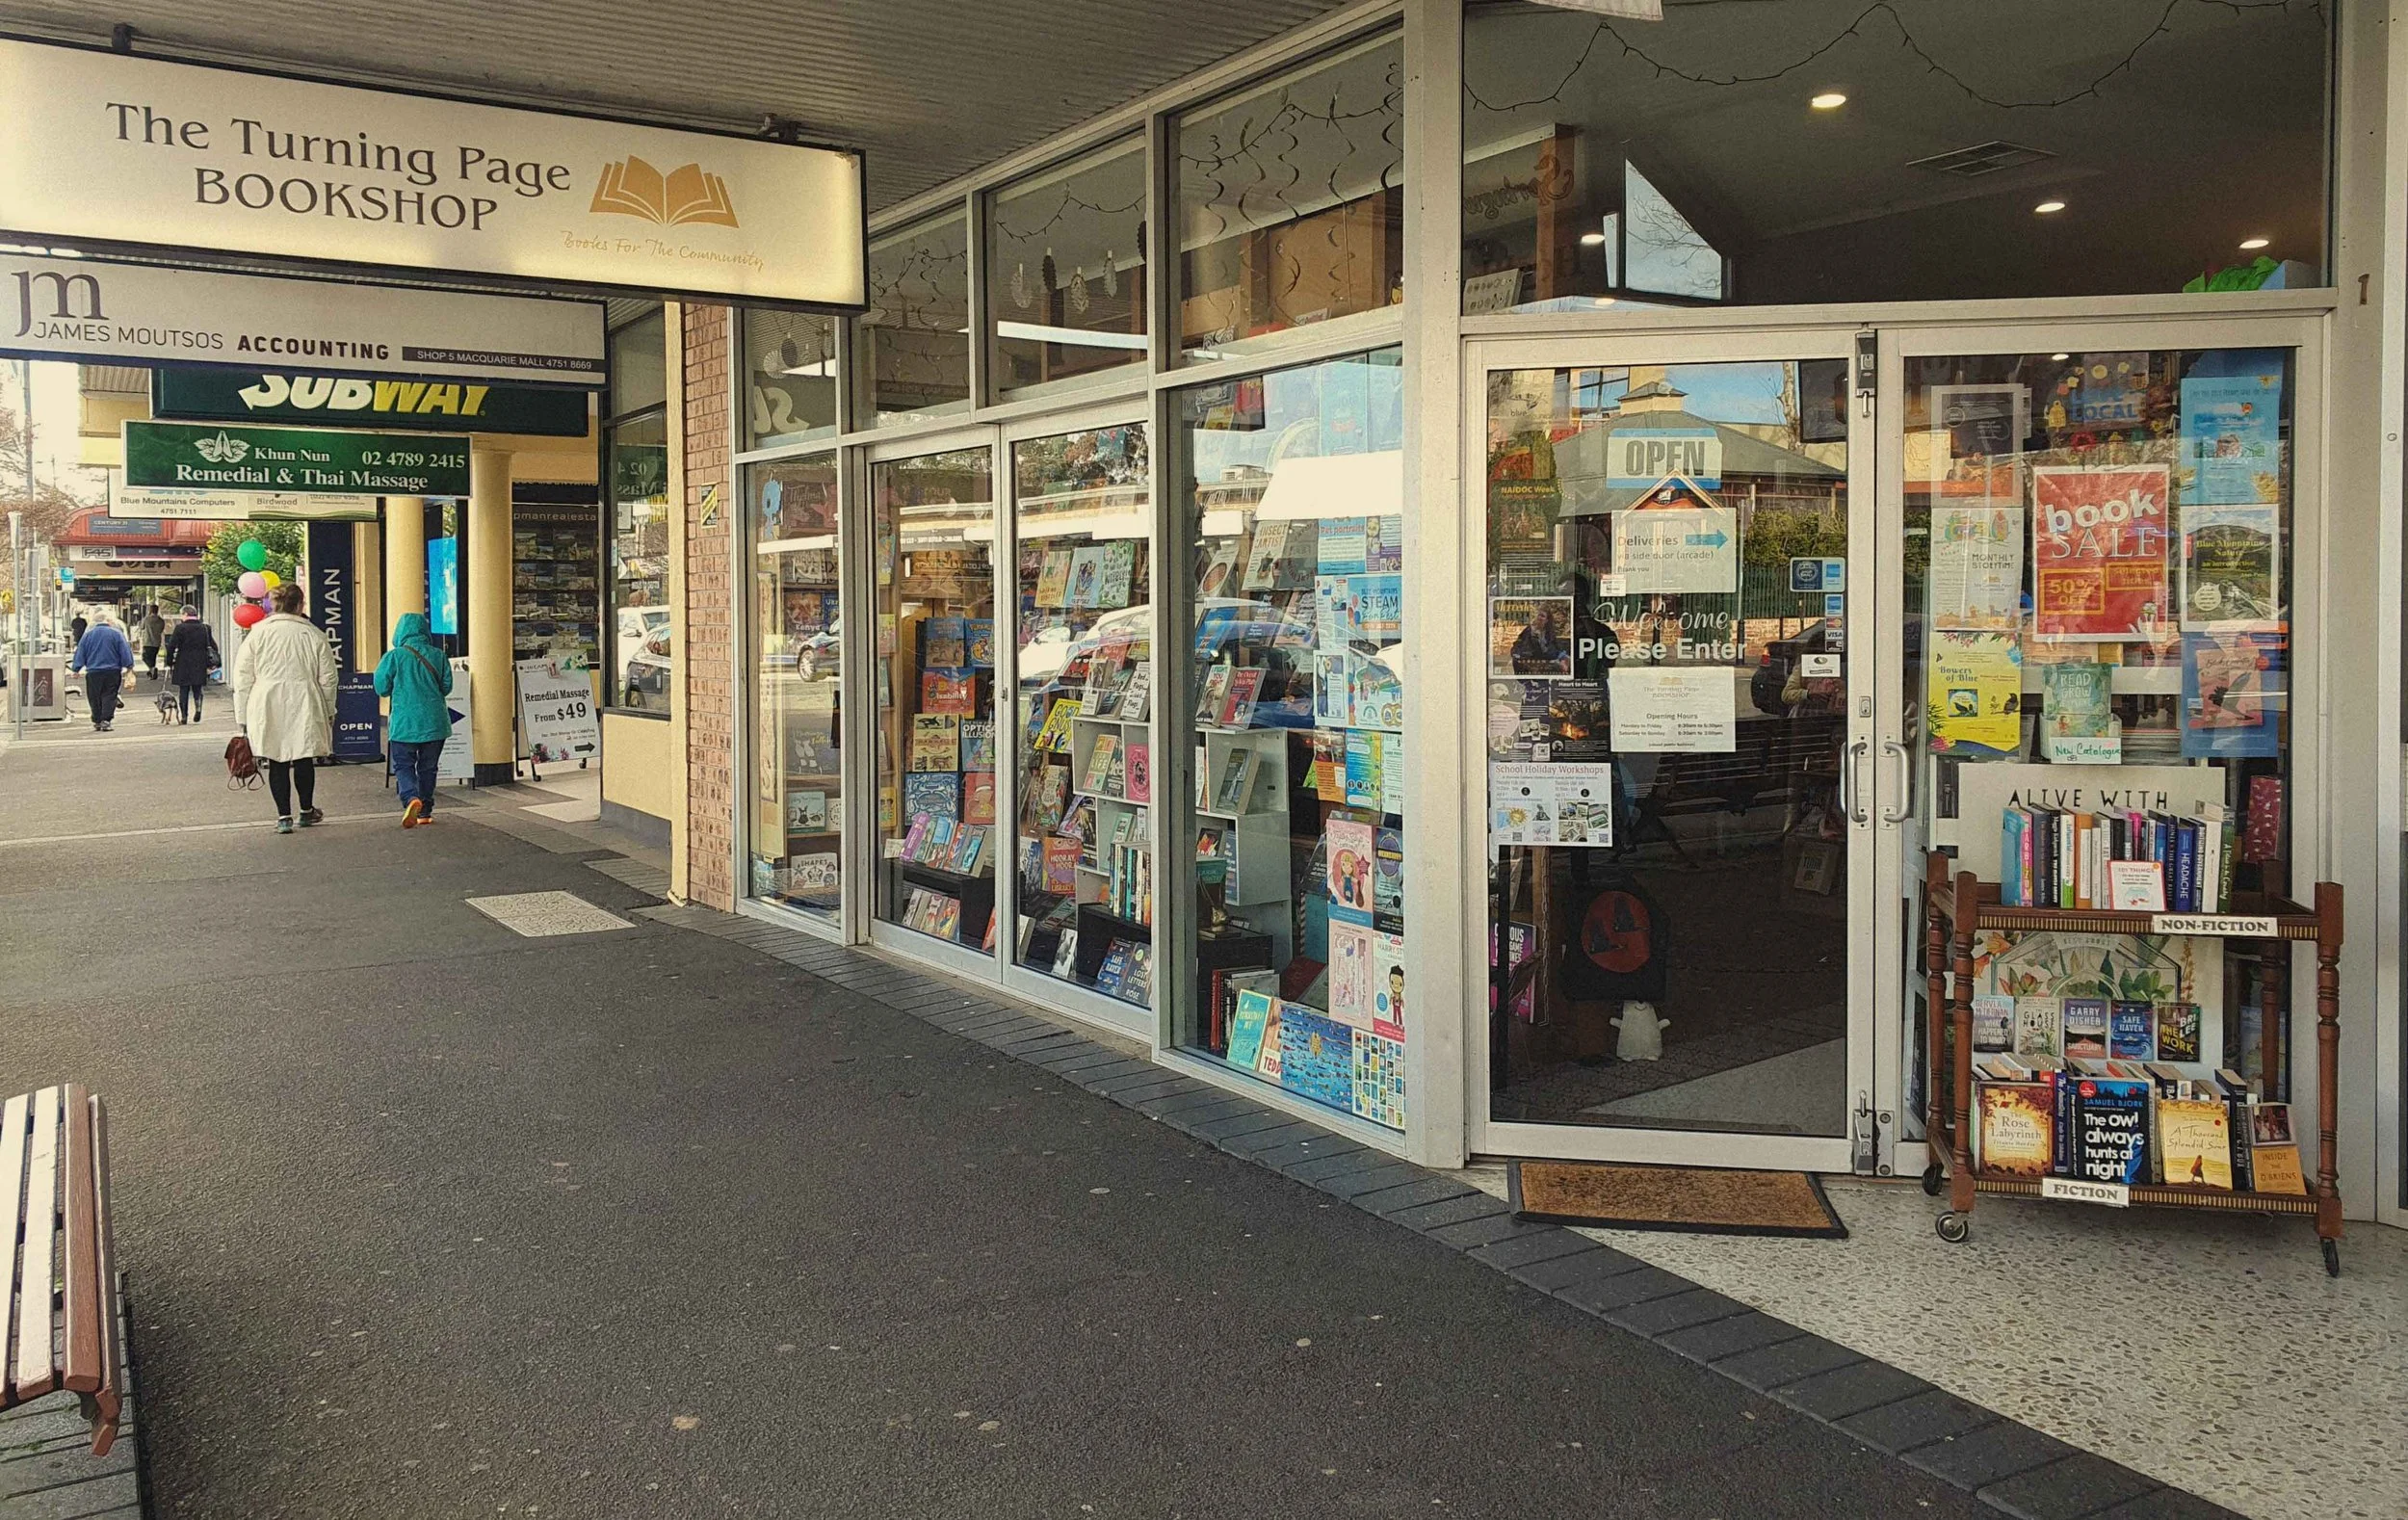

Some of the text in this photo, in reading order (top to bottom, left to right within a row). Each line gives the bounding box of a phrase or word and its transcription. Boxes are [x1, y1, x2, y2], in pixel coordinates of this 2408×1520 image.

[106, 102, 570, 197] The Turning Page
[196, 168, 497, 231] BOOKSHOP
[561, 230, 764, 272] Books For The Community
[2357, 273, 2370, 305] 1
[34, 322, 389, 360] JAMES MOUTSOS ACCOUNTING
[417, 350, 592, 371] SHOP 5 MACQUARIE MALL 4751 8669
[238, 374, 489, 417] SUBWAY
[254, 447, 465, 469] Khun Nun 02 4789 2415
[1626, 440, 1706, 477] OPEN
[176, 464, 429, 491] Remedial & Thai Massage
[1501, 485, 1555, 494] NAIDOC Week
[120, 496, 236, 507] Blue Mountains Computers
[256, 497, 298, 506] Birdwood
[2045, 488, 2160, 533] book
[1618, 535, 1679, 548] Deliveries
[2050, 527, 2158, 559] SALE
[1632, 550, 1650, 560] side
[1676, 550, 1714, 561] (arcade)
[1637, 566, 1650, 575] you
[2050, 579, 2095, 594] 50%
[1361, 595, 1399, 609] STEAM
[1593, 601, 1729, 631] Welcome
[1579, 638, 1748, 660] Please Enter
[1940, 666, 1973, 674] Bowers
[2060, 673, 2092, 687] READ
[525, 688, 590, 703] Remedial Massage
[535, 701, 587, 722] From $49
[340, 722, 373, 731] OPEN
[2055, 745, 2073, 757] New
[1495, 765, 1605, 774] School Holiday Workshops
[2008, 788, 2168, 809] ALIVE WITH
[2180, 852, 2190, 899] HEADACHE
[2161, 919, 2269, 932] NON-FICTION
[2070, 1008, 2100, 1016] GARRY
[2122, 1015, 2141, 1024] SAFE
[2070, 1016, 2101, 1025] DISHER
[2180, 1013, 2197, 1028] BRI
[2119, 1024, 2144, 1033] HAVEN
[2179, 1023, 2196, 1038] LEE
[2067, 1042, 2102, 1051] SANCTUARY
[2161, 1035, 2194, 1055] WORK
[2002, 1116, 2030, 1128] Rose
[2083, 1114, 2107, 1126] The
[1991, 1127, 2042, 1140] Labyrinth
[2085, 1127, 2144, 1147] always
[2170, 1125, 2224, 1139] A Thousand
[2166, 1138, 2226, 1150] Splendid Suns
[2085, 1146, 2133, 1161] hunts at
[2263, 1152, 2289, 1161] INSIDE
[2086, 1160, 2127, 1180] night
[2054, 1184, 2118, 1200] FICTION
